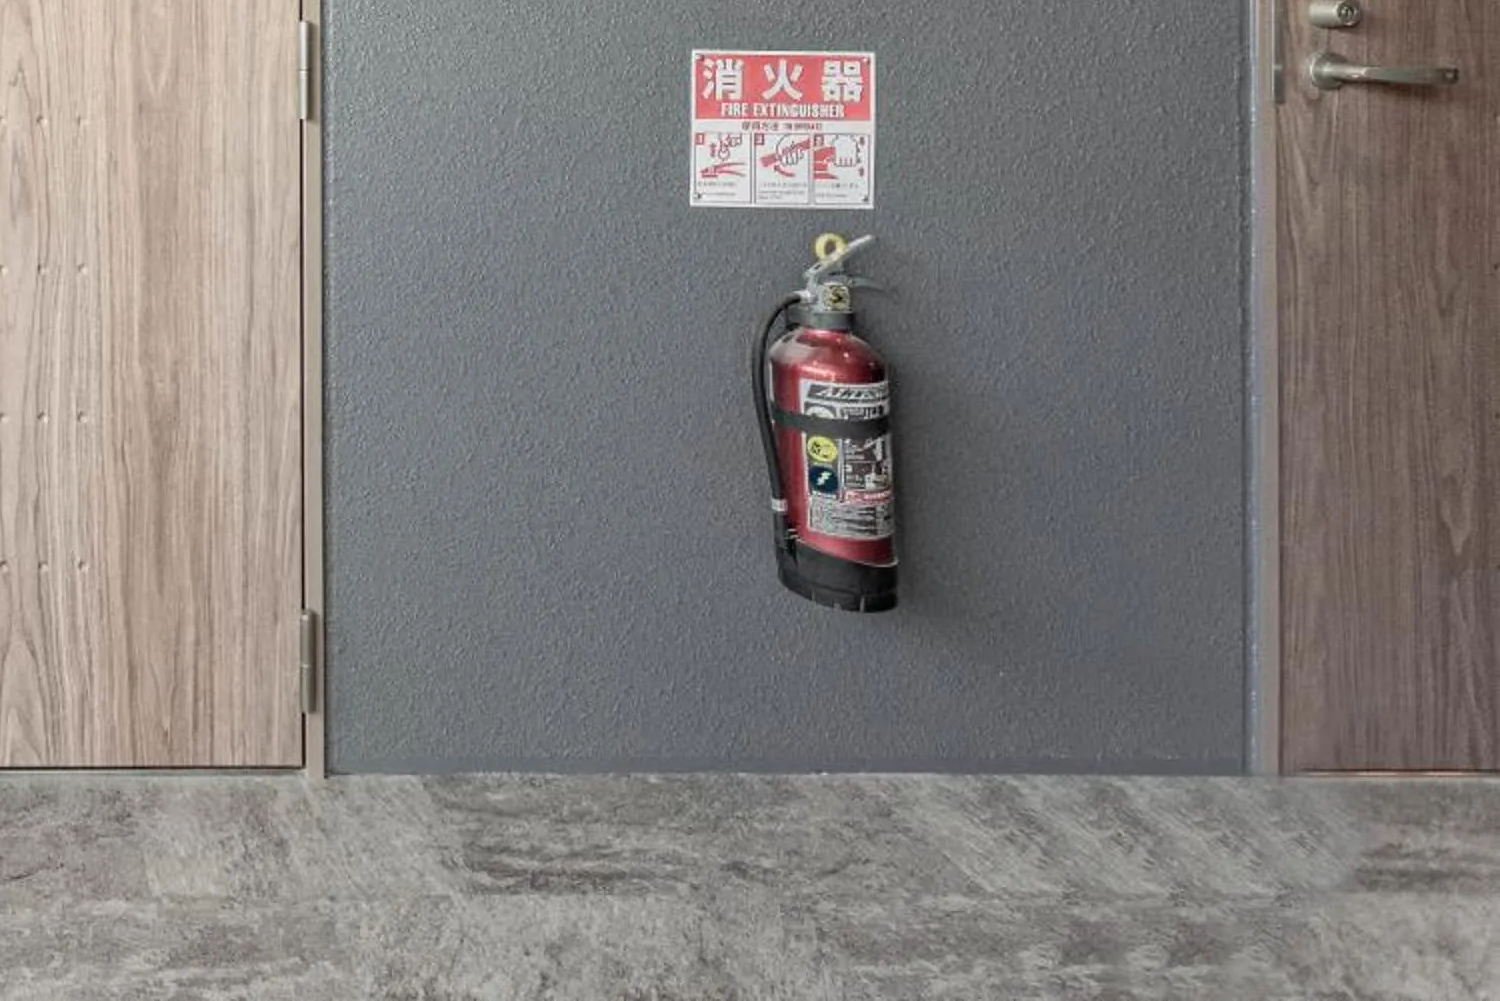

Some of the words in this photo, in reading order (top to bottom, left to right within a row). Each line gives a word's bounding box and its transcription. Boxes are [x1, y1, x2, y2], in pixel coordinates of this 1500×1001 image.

[702, 58, 863, 102] 消火器
[721, 102, 748, 117] FIRE
[753, 103, 844, 118] EXTINGUISHER
